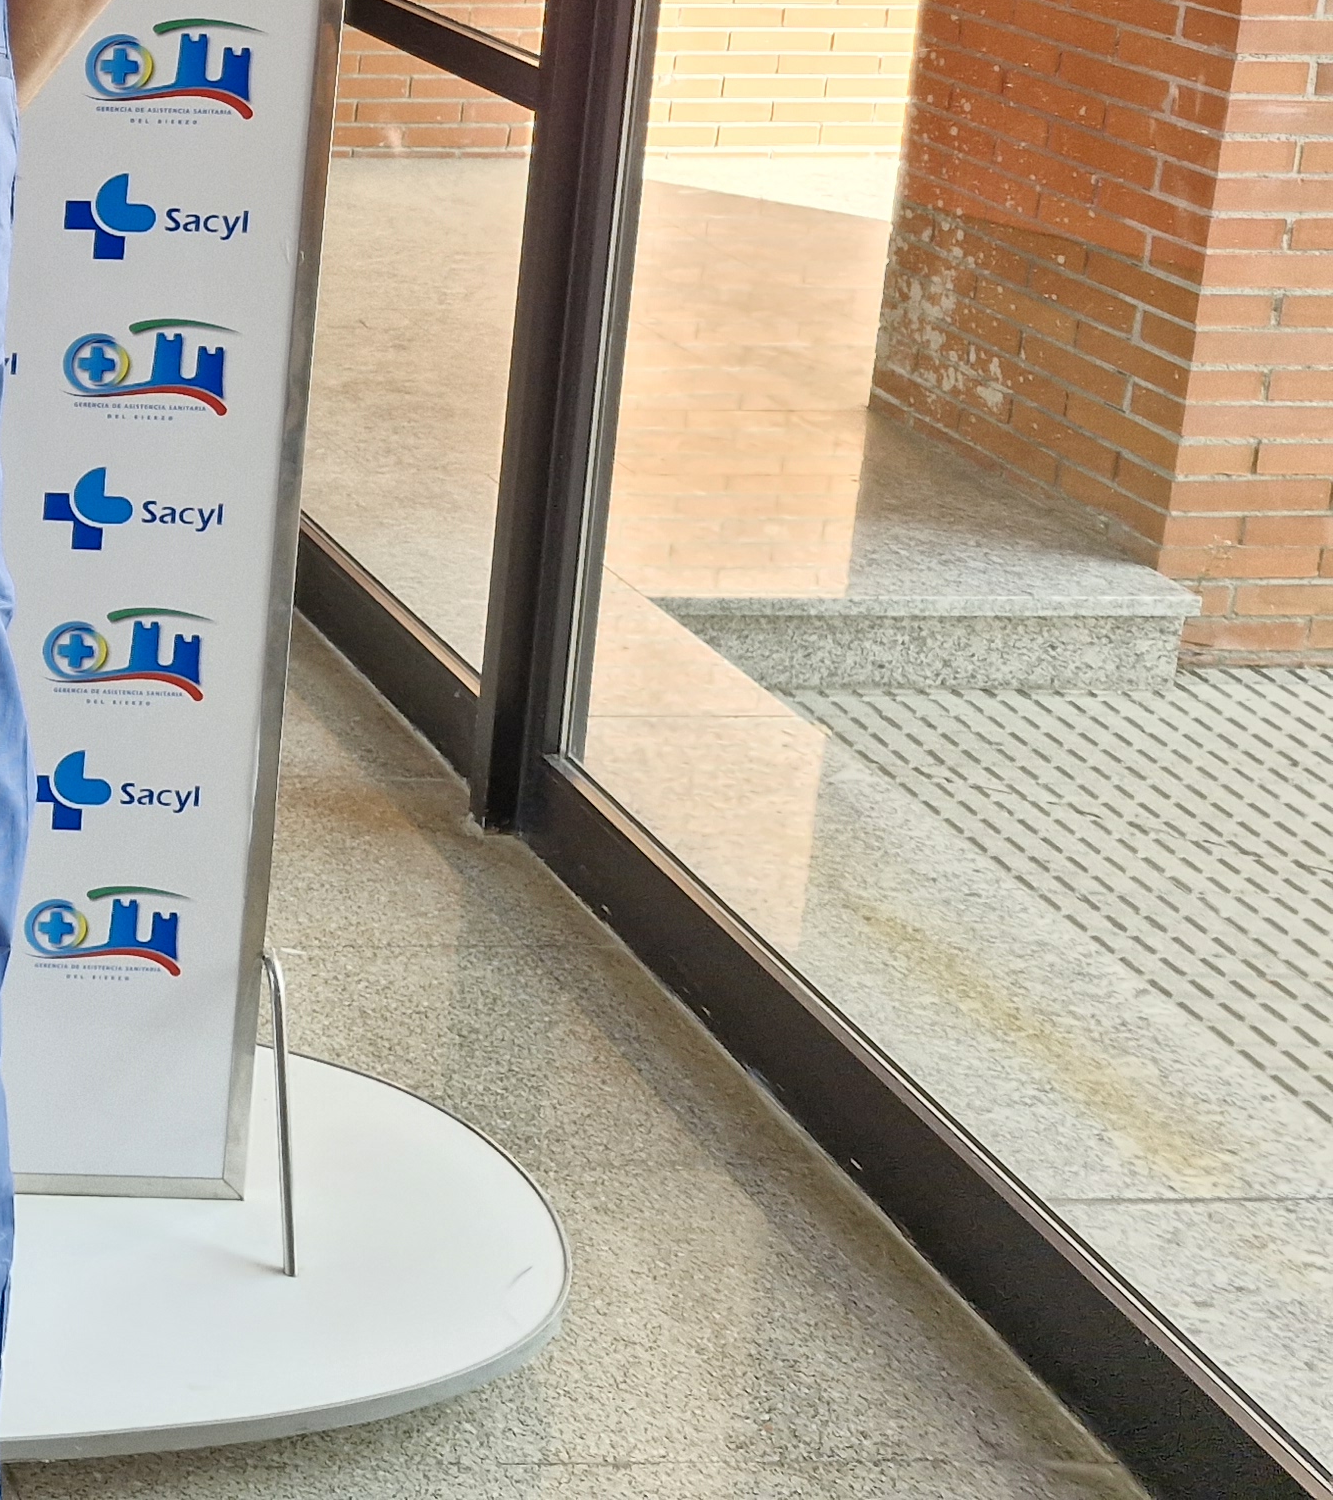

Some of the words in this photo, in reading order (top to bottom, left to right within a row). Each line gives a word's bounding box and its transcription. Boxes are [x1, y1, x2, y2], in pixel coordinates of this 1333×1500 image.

[164, 206, 250, 241] Sacyl
[140, 499, 225, 532] Sacyl
[118, 782, 201, 814] Sacyl
